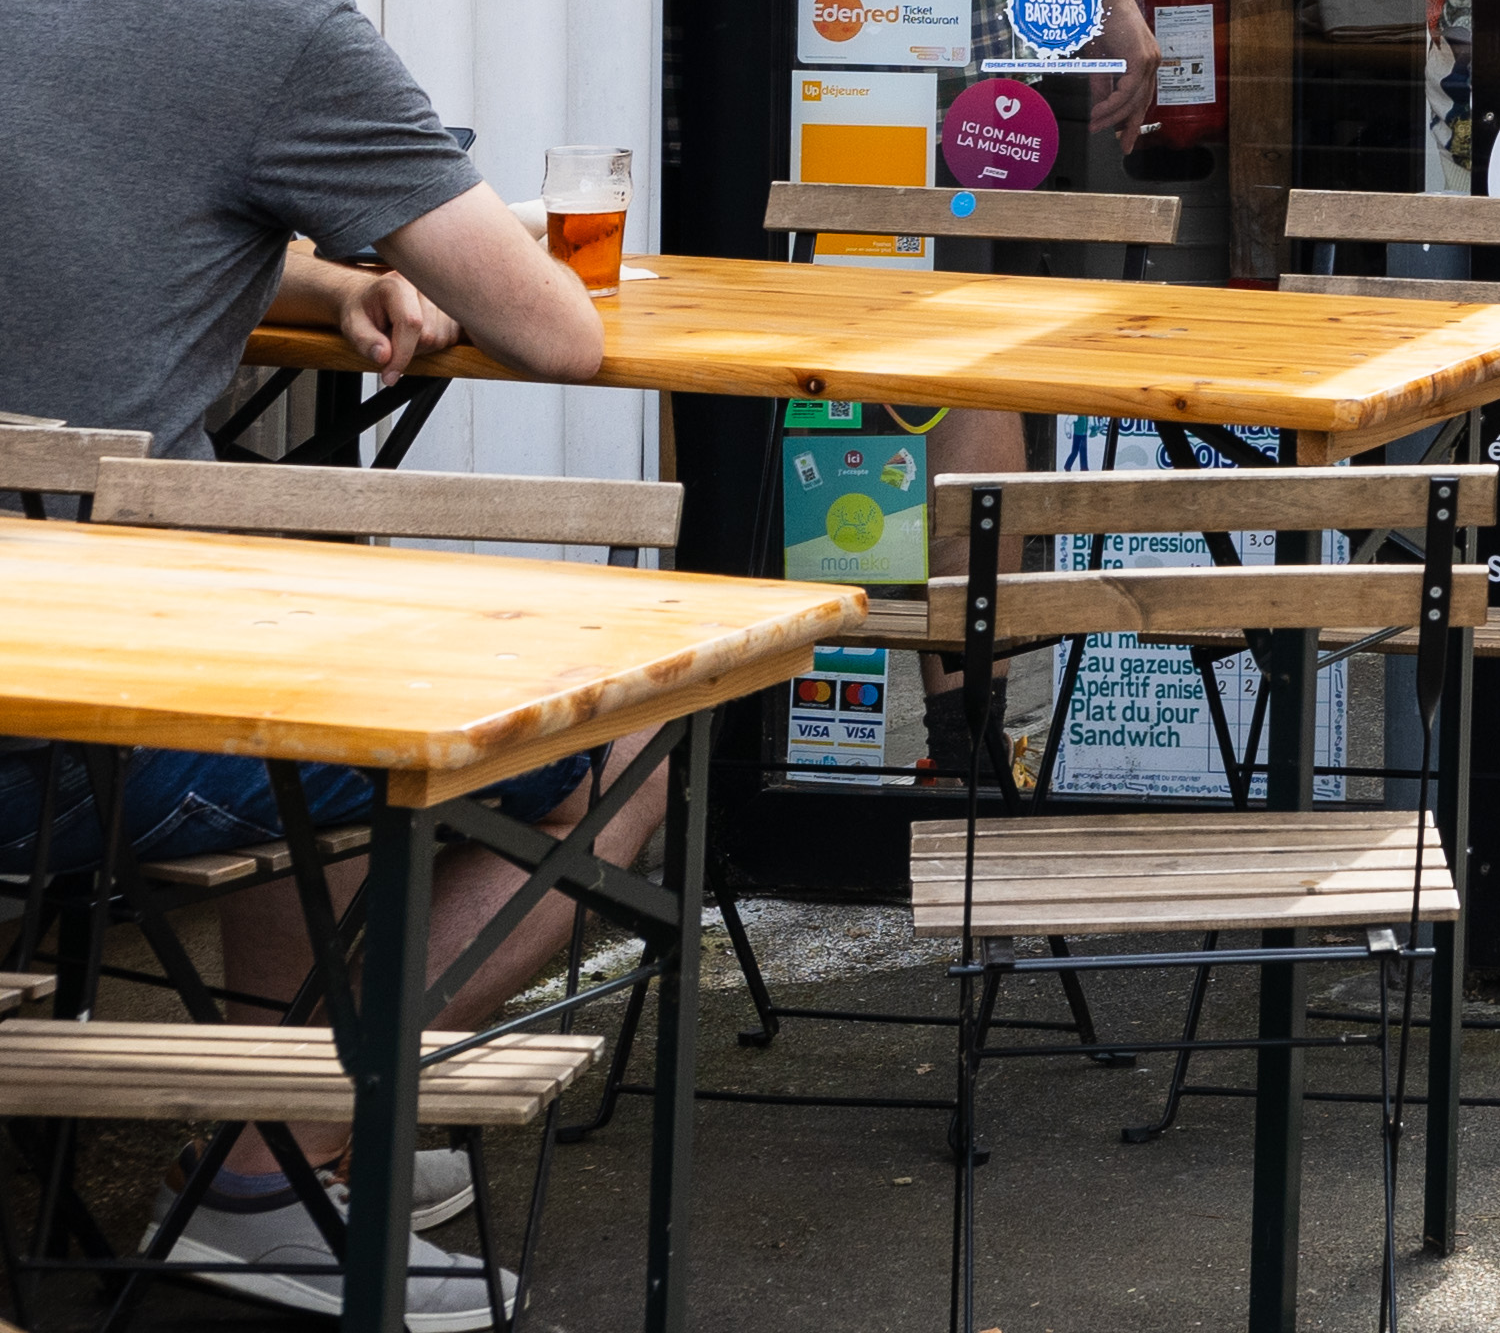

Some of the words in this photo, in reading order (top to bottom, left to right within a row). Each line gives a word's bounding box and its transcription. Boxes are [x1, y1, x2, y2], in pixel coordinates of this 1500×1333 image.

[812, 3, 900, 23] Edenred
[902, 5, 933, 16] Ticket
[902, 14, 960, 26] Restaurant
[1042, 29, 1068, 40] 2024
[804, 84, 819, 98] Up
[822, 85, 870, 98] déjeuner
[962, 121, 981, 134] ICI
[983, 126, 1004, 140] ON
[1005, 132, 1041, 149] AIME
[956, 134, 974, 147] LA
[977, 139, 1040, 163] MUSIQUE
[847, 454, 860, 463] ici
[838, 467, 869, 476] j'accepte
[1129, 535, 1206, 554] pression
[821, 555, 890, 572] moneko
[1072, 676, 1150, 699] Apéritif
[1154, 678, 1204, 700] anisé
[1069, 698, 1116, 722] Plat
[1121, 700, 1150, 723] du
[1154, 705, 1200, 726] jour
[797, 723, 831, 738] VISA
[843, 725, 876, 740] VISA
[1069, 722, 1181, 748] Sandwich
